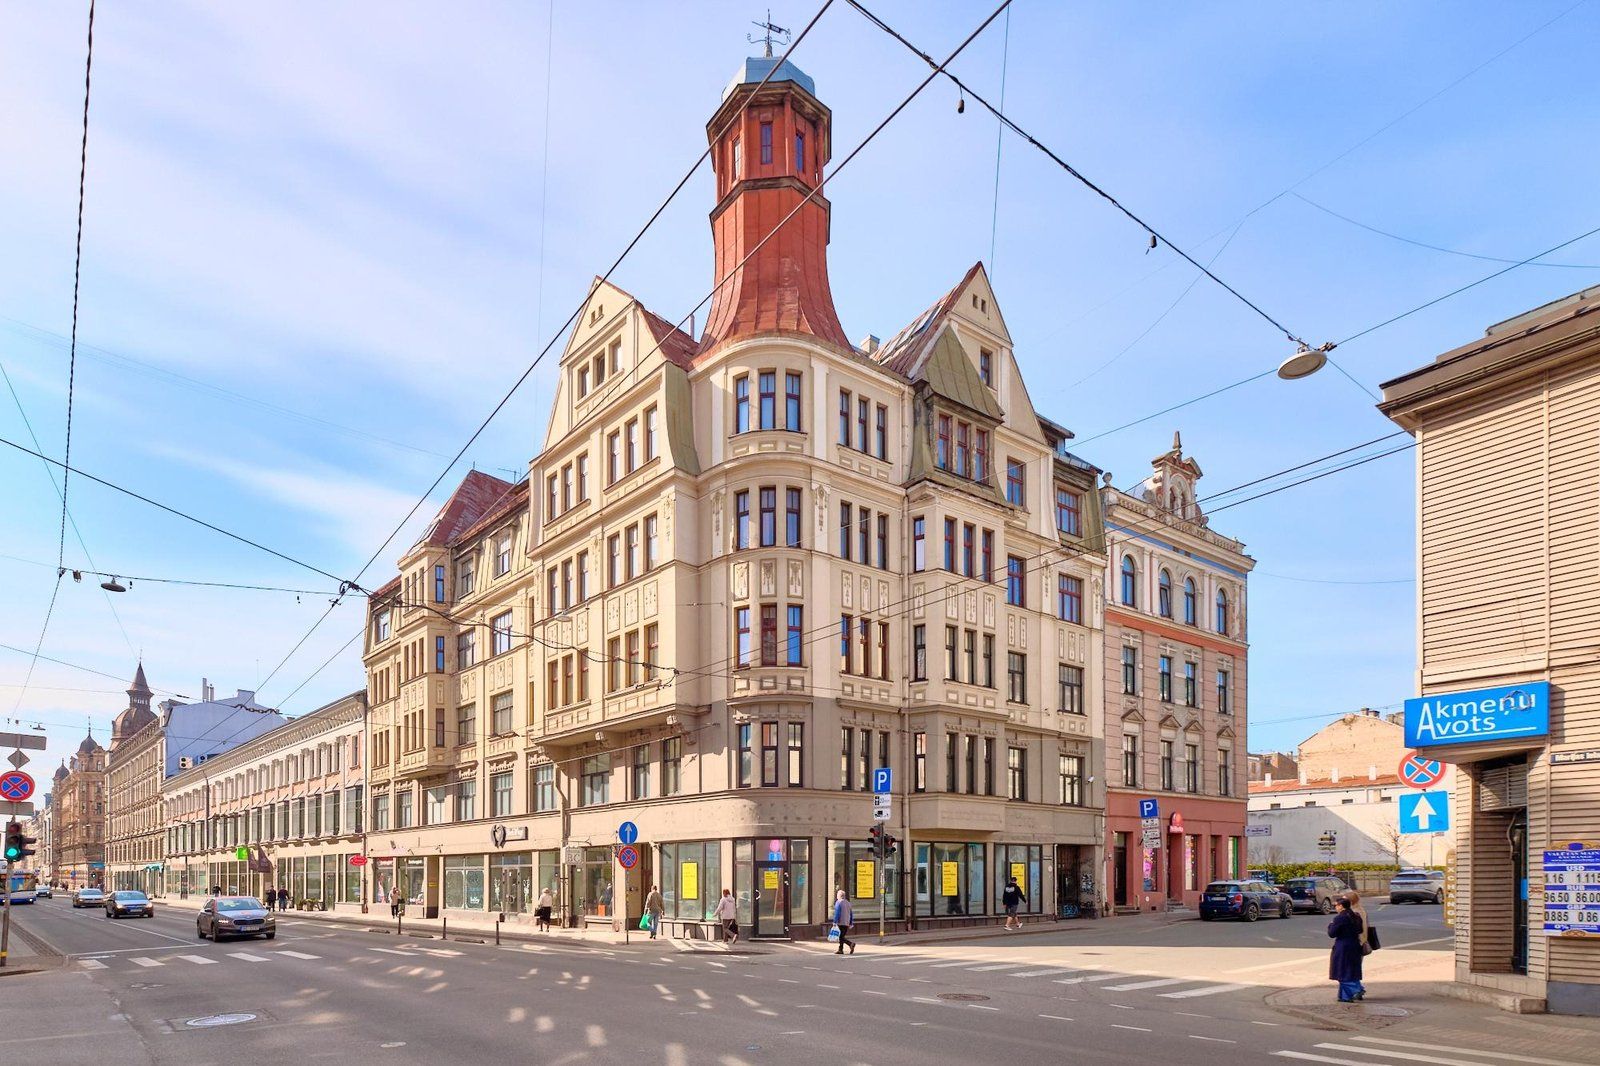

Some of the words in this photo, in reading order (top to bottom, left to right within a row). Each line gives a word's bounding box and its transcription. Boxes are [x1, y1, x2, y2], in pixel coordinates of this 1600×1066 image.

[1416, 694, 1535, 739] Akmeņu
[877, 771, 887, 790] P
[1143, 801, 1153, 816] P
